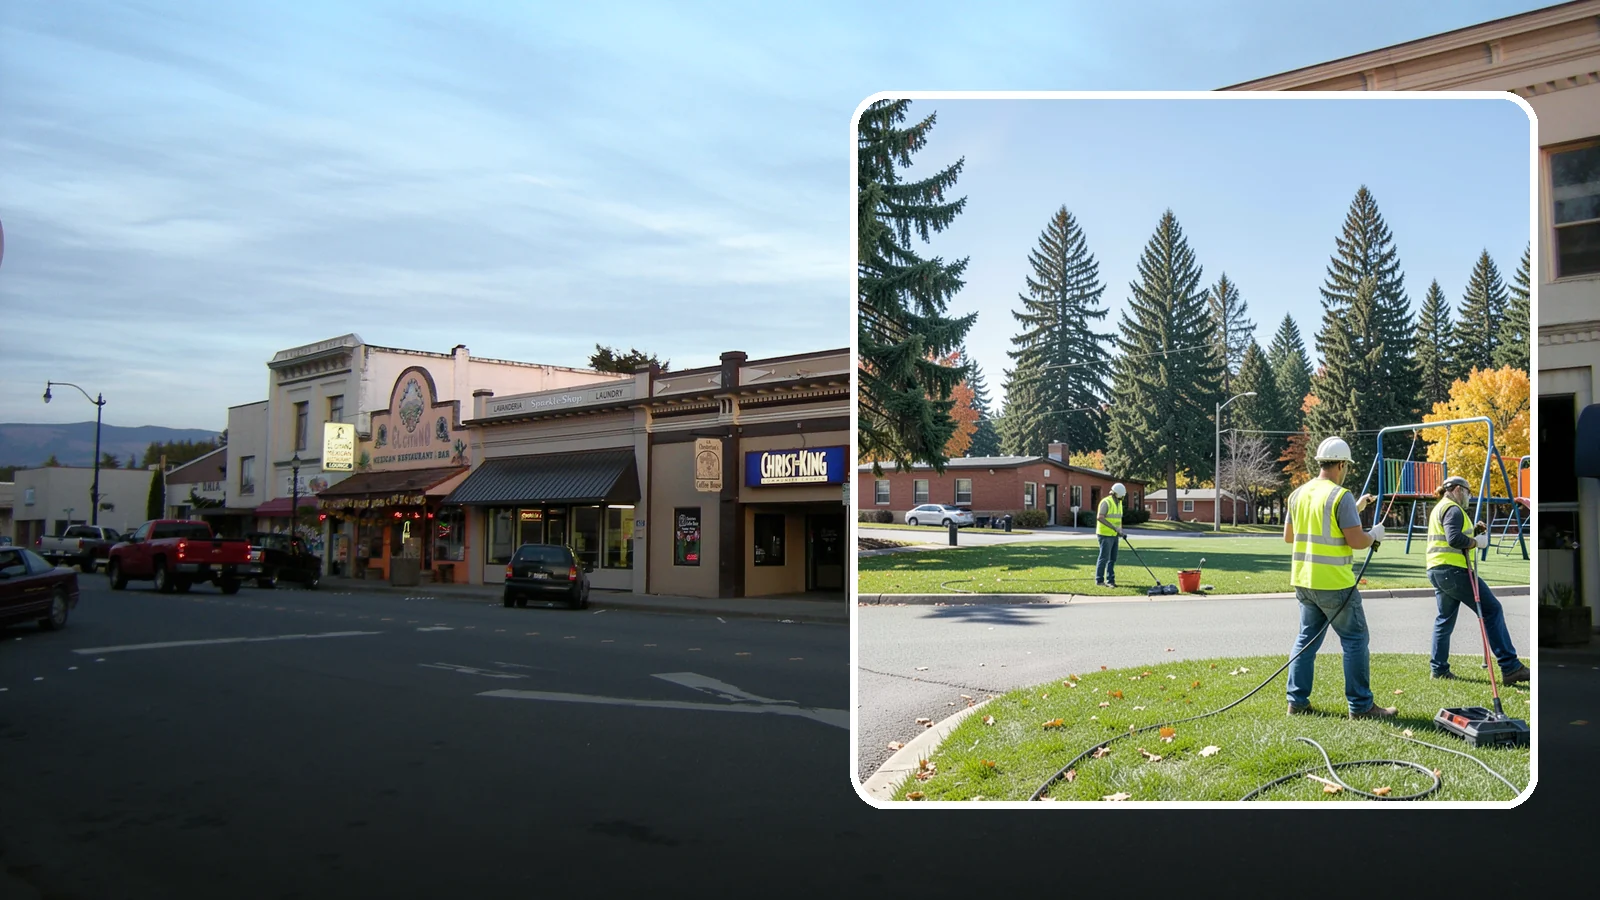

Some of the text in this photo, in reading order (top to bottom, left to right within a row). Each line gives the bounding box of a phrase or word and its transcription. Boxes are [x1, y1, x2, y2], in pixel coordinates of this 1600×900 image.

[531, 394, 582, 408] Sparkle Shop
[596, 389, 624, 400] LAUNDRY
[493, 402, 523, 413] LAVANDERIA
[392, 425, 402, 449] EL
[373, 455, 396, 464] MEXICAN
[397, 451, 433, 462] RESTAURANT
[438, 450, 450, 459] BAR
[761, 450, 827, 478] CHRIST KING
[697, 480, 722, 489] Coffee House
